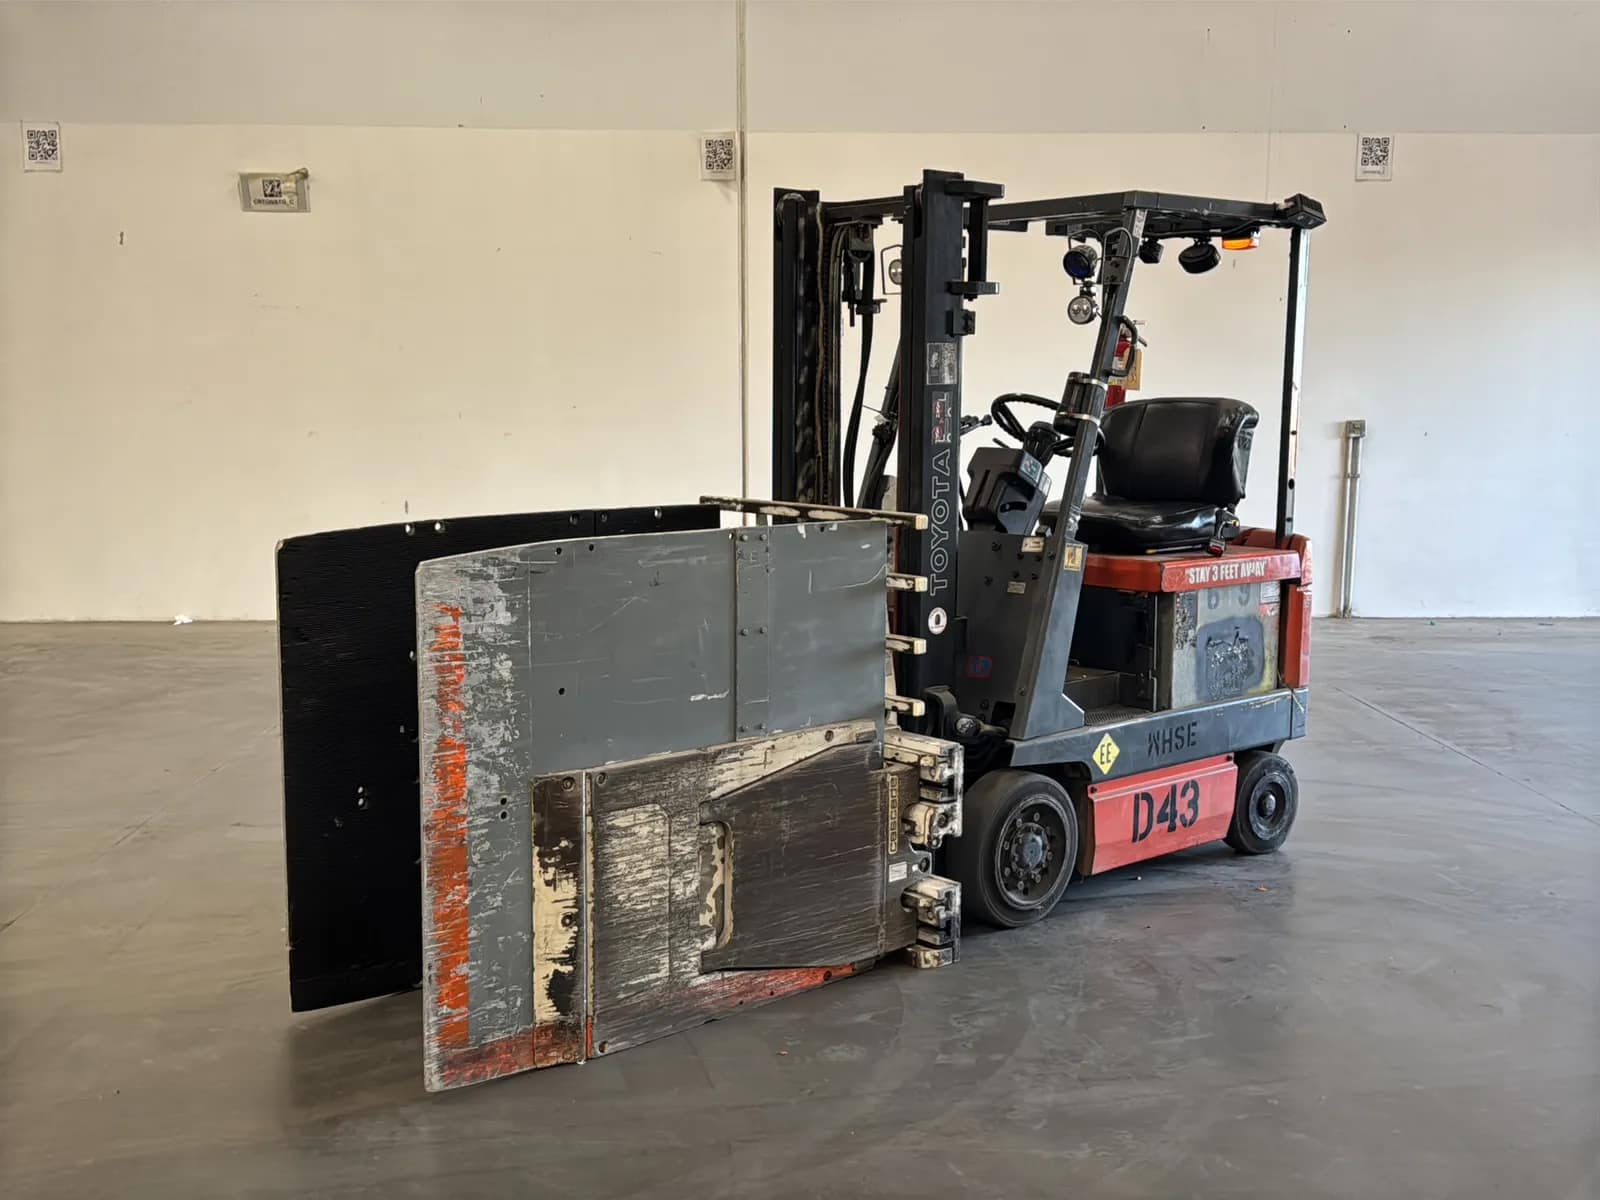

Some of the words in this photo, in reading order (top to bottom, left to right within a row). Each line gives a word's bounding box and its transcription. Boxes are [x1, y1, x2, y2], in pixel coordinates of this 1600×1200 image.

[930, 449, 950, 596] TOYOTA
[1212, 565, 1219, 582] 3
[1220, 563, 1239, 580] FEET
[1100, 742, 1112, 765] EE
[1132, 779, 1200, 843] D43
